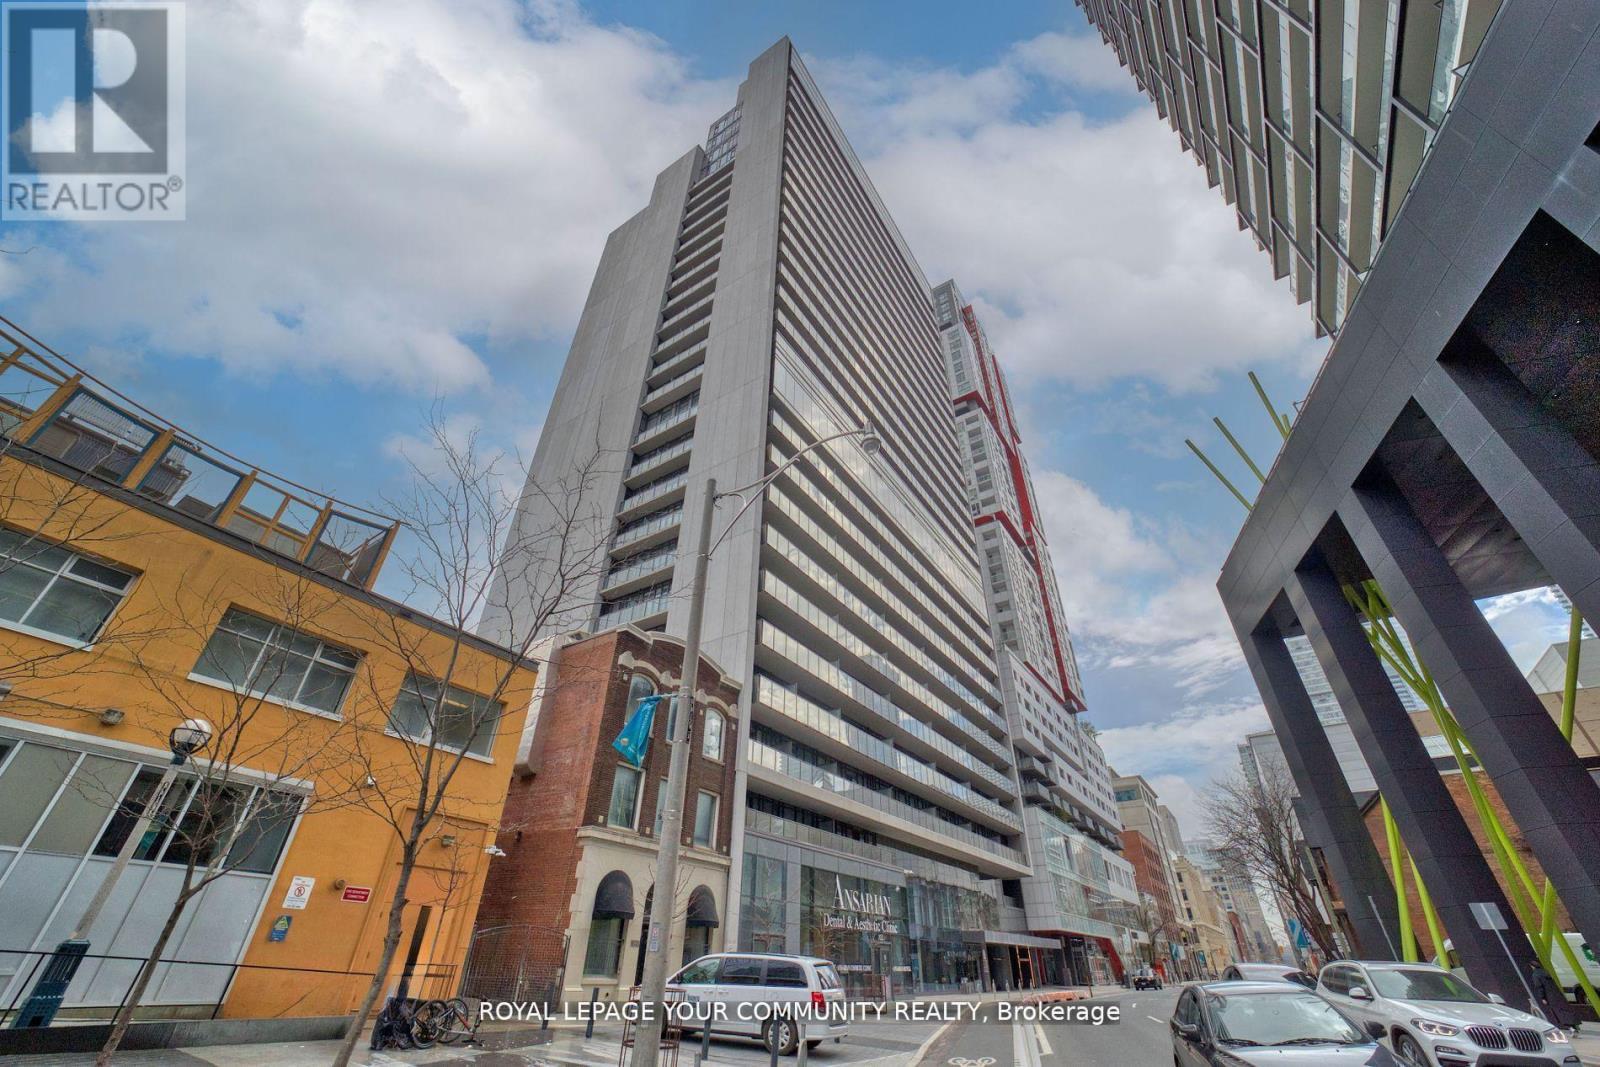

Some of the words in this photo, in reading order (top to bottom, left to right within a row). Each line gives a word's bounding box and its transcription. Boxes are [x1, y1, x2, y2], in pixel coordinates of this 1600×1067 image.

[823, 913, 846, 929] Dental
[846, 916, 853, 929] &
[881, 920, 898, 934] Clinic
